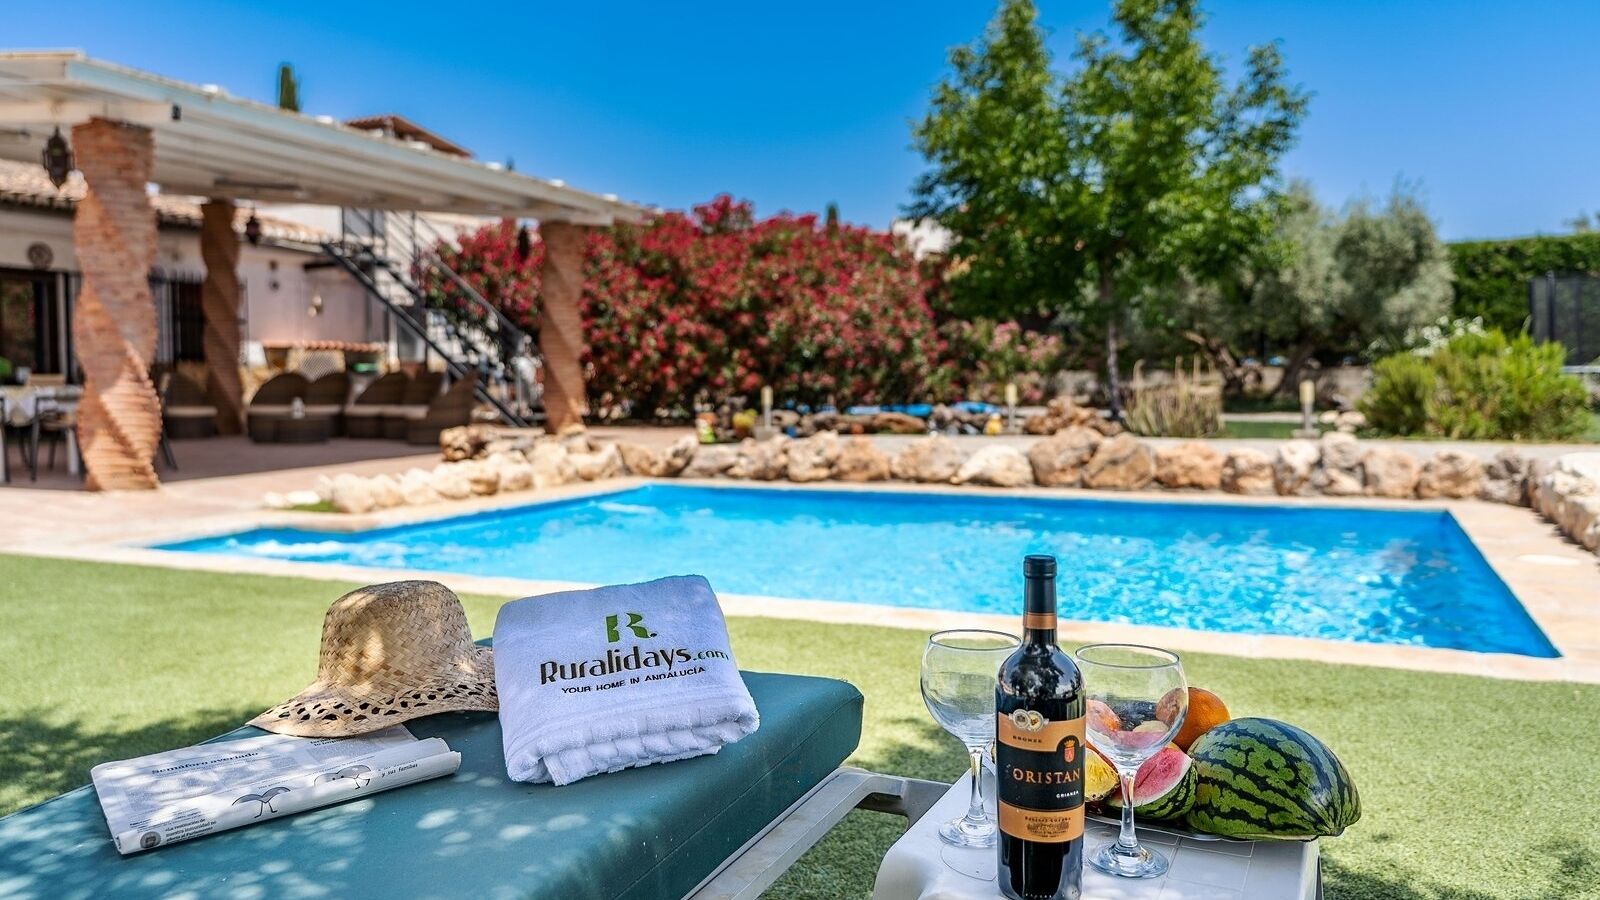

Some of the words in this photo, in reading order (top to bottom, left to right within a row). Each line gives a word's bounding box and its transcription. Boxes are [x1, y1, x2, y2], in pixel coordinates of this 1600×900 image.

[540, 646, 729, 685] Ruralidays.com
[561, 685, 592, 694] YOUR
[596, 679, 626, 691] HOME
[630, 676, 641, 685] IN
[210, 752, 259, 764] averiado
[1012, 768, 1081, 785] ORISTAN
[1056, 789, 1079, 799] CRIANZA
